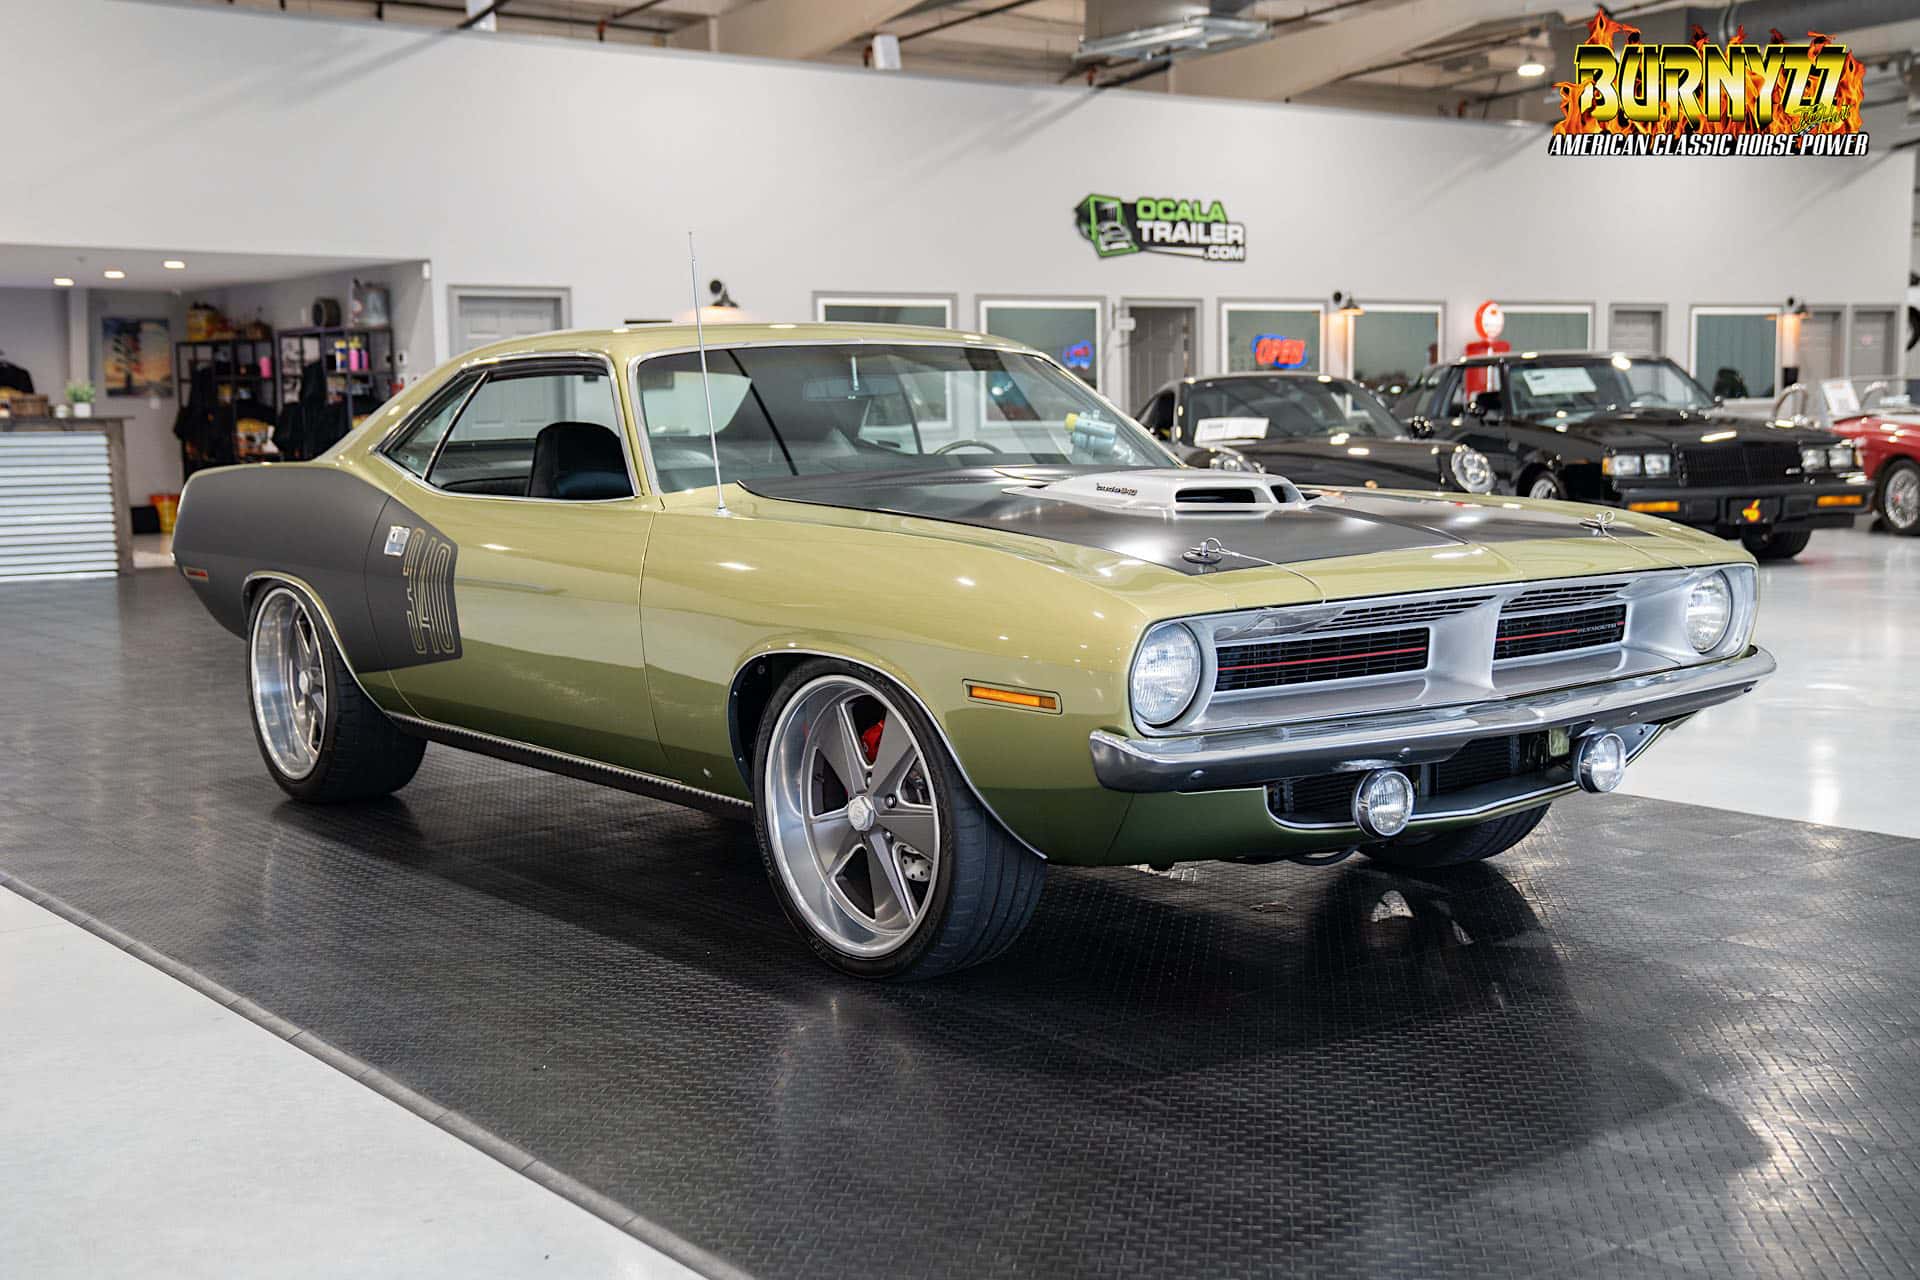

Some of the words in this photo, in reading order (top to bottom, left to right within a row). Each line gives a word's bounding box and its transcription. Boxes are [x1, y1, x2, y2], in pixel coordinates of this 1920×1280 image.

[1136, 197, 1228, 222] OCALA
[1136, 220, 1245, 245] TRAILER
[1203, 245, 1245, 261] .COM
[1256, 338, 1304, 365] OPEN
